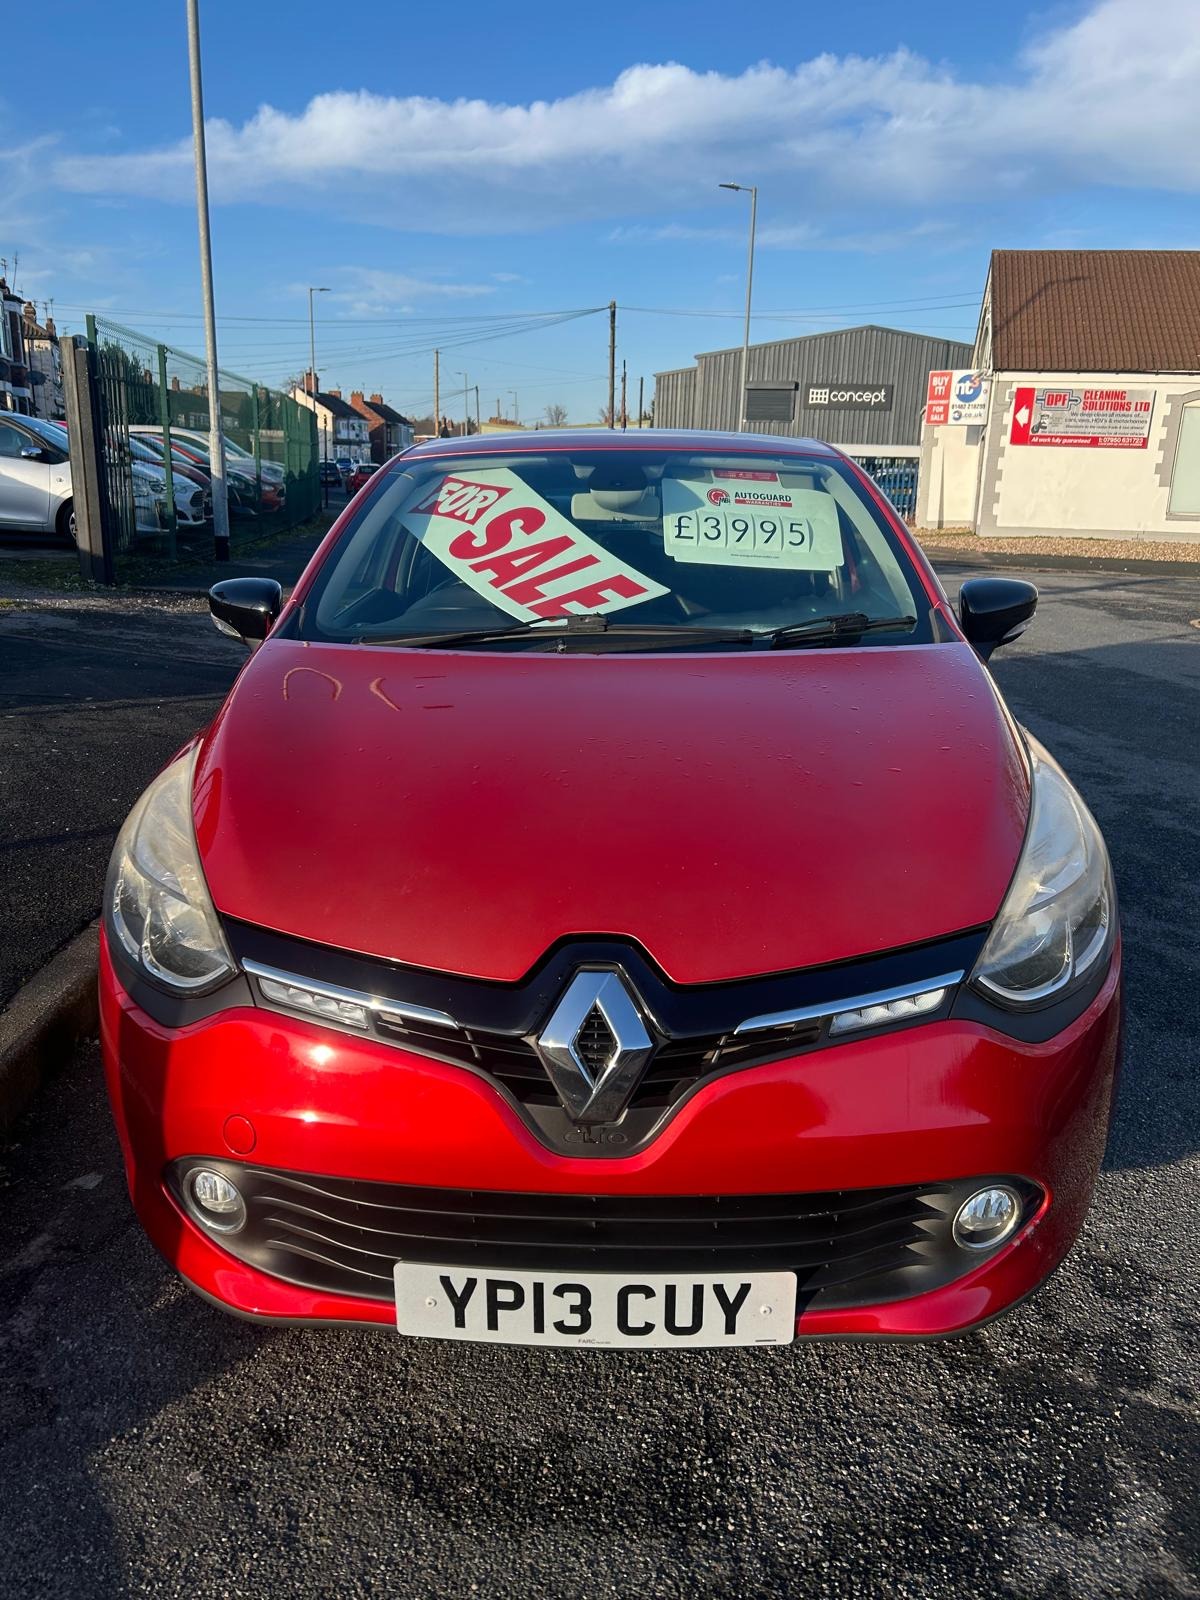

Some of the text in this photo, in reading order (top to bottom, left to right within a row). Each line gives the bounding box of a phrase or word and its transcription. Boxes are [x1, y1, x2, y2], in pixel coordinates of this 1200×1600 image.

[932, 376, 950, 386] BUY
[830, 388, 886, 406] concept
[1046, 393, 1068, 406] DPF
[1083, 390, 1127, 401] CLEANING
[932, 405, 944, 413] FOR
[1082, 401, 1151, 412] SOLUTIONS LTD
[418, 482, 499, 521] FOR
[734, 491, 792, 502] AUTOGUARD
[674, 515, 805, 547] £3995
[448, 506, 649, 623] SALE
[438, 1275, 752, 1336] YP13 CUY
